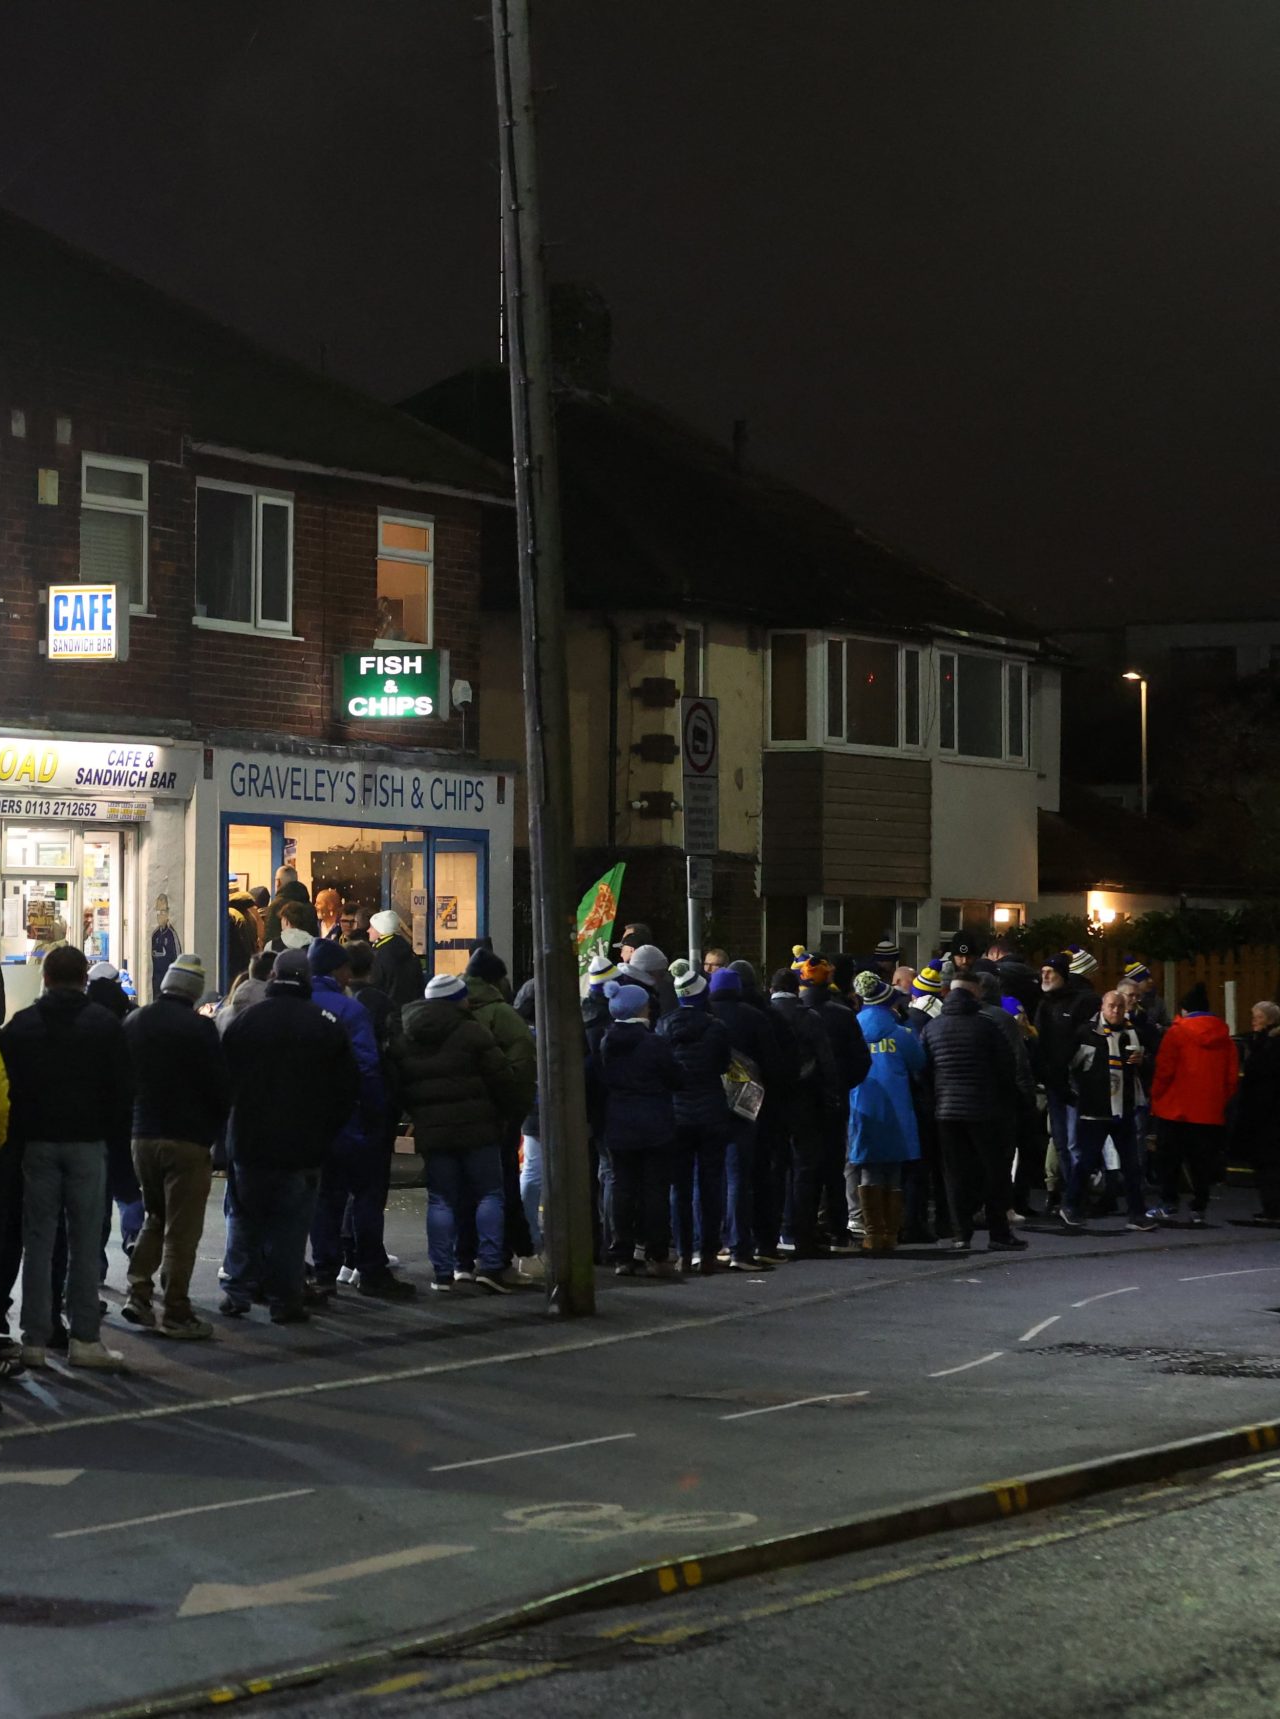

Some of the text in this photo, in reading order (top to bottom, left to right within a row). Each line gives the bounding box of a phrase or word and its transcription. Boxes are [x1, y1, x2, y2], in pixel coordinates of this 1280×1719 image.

[53, 593, 112, 631] CAFE
[53, 638, 112, 652] SANDWICH BAR
[360, 655, 422, 675] FISH
[383, 679, 398, 693] &
[348, 696, 433, 717] CHIPS
[107, 749, 154, 768] CAFE &
[75, 767, 177, 789] SANDWICH BAR
[230, 762, 484, 812] GRAVELEY'S FISH & CHIPS
[25, 800, 50, 815] 0113
[53, 801, 97, 817] 2712652
[413, 895, 425, 906] OUT
[870, 1038, 896, 1054] EDS
